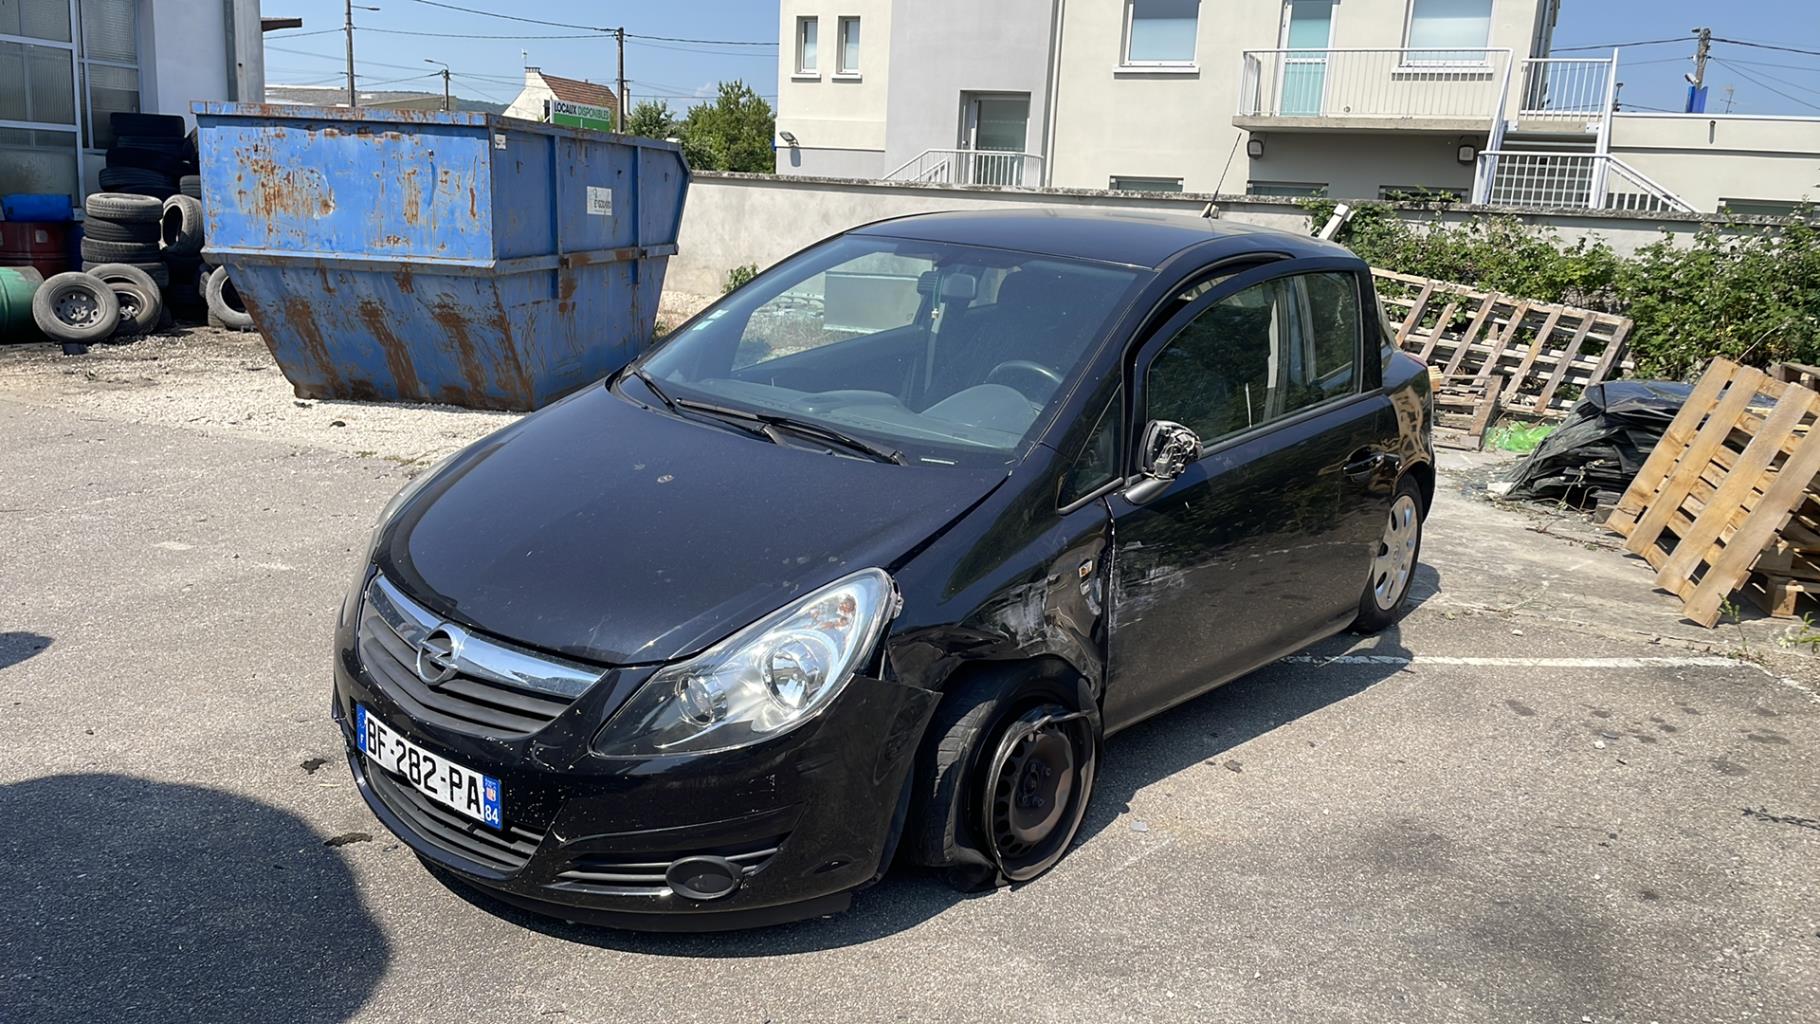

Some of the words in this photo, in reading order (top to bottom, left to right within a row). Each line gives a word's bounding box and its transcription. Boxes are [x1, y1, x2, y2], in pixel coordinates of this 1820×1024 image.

[554, 101, 577, 115] LOCAUX
[577, 105, 609, 120] DISPONIBLES
[360, 734, 364, 744] F
[367, 717, 481, 815] BF-282-PA
[485, 804, 499, 825] 84
